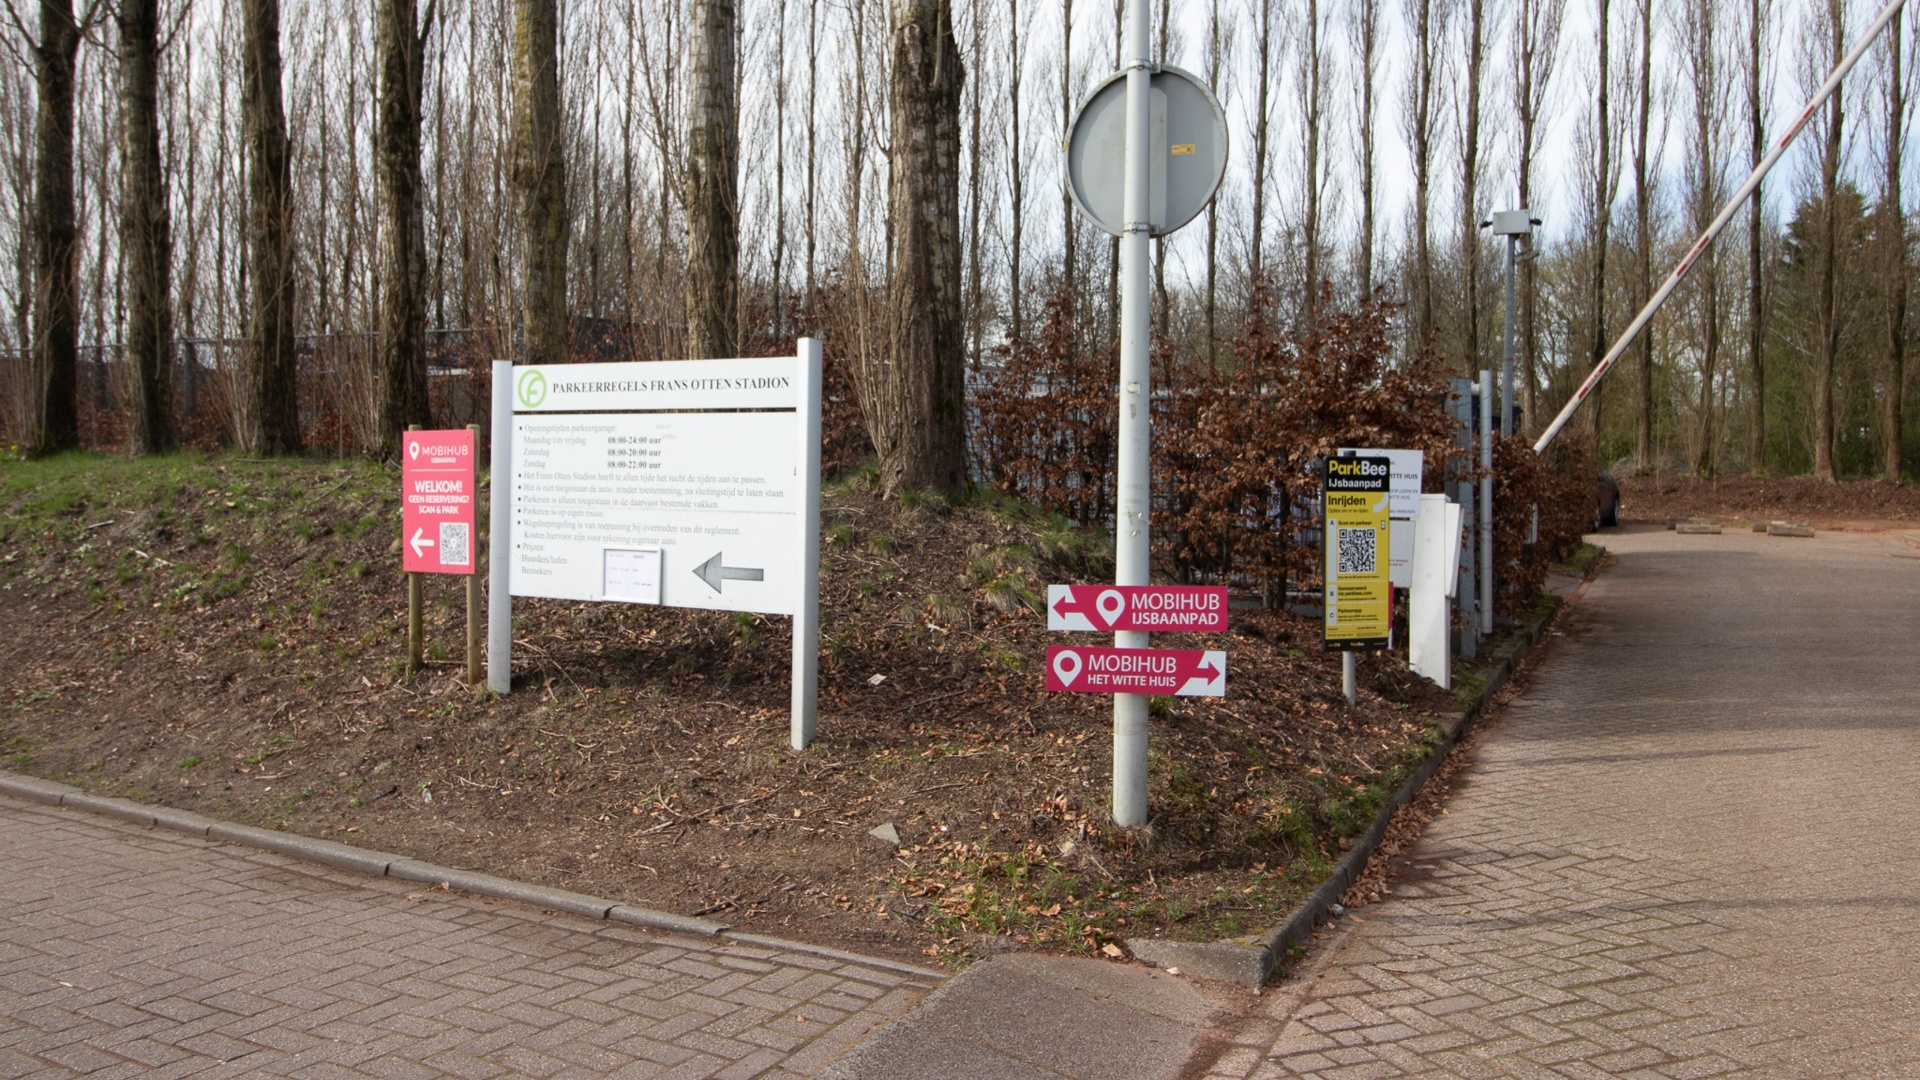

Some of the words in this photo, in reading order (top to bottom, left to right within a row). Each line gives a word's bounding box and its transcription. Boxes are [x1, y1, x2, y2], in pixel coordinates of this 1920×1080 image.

[553, 380, 648, 393] PARKEERREGELS
[650, 380, 688, 391] FRANS
[690, 378, 732, 390] OTTEN
[735, 377, 790, 389] STADION
[524, 424, 570, 434] Openingstijden
[571, 425, 616, 434] parkeergarage:
[523, 436, 551, 446] Maandag
[564, 437, 586, 446] vrijdag
[607, 436, 648, 444] 08:00-24:00
[422, 445, 468, 456] MOBIHUB
[523, 448, 550, 457] Zaterdag
[523, 460, 546, 469] Zondag
[607, 460, 648, 468] 08:00-22:00
[1329, 460, 1387, 476] ParkBee
[523, 472, 535, 480] Het
[536, 472, 553, 480] Frans
[554, 472, 571, 480] Otten
[573, 472, 596, 480] Stadion
[598, 472, 614, 481] heeft
[623, 473, 639, 481] allen
[640, 474, 655, 484] tijde
[657, 474, 667, 482] het
[668, 474, 685, 482] recht
[687, 474, 695, 482] de
[697, 474, 716, 484] tijden
[740, 477, 766, 485] passen.
[1329, 478, 1382, 489] IJsbaanpad
[414, 481, 463, 493] WELKOM!
[555, 485, 588, 494] toegestaan
[598, 486, 614, 494] auto,
[616, 486, 637, 494] zonder
[639, 487, 683, 497] toestemming,
[695, 488, 736, 498] sluitingstijd
[746, 488, 763, 497] laten
[408, 495, 425, 503] GEEN
[425, 495, 469, 503] RESERVERING?
[523, 495, 550, 504] Parkeren
[578, 498, 610, 506] toegestaan
[630, 498, 658, 506] daarvoor
[660, 499, 692, 508] bestemde
[694, 500, 719, 508] vakken.
[1328, 495, 1366, 507] Inrijden
[418, 505, 435, 514] SCAN
[436, 506, 441, 514] &
[442, 506, 459, 514] PARK
[523, 507, 550, 516] Parkeren
[558, 510, 566, 518] op
[567, 510, 584, 519] eigen
[523, 519, 576, 529] Wegsleepregeling
[598, 522, 631, 532] toepassing
[632, 523, 641, 533] bij
[643, 523, 677, 532] overtreden
[693, 525, 702, 533] dit
[524, 531, 545, 540] Kosten
[546, 532, 572, 540] hiervoor
[574, 532, 585, 543] zijn
[603, 534, 630, 544] rekening
[632, 535, 659, 545] eigenaar
[521, 566, 552, 575] Bezoekers
[1131, 593, 1220, 610] MOBIHUB
[1132, 613, 1219, 625] IJSBAANPAD
[1088, 654, 1177, 674] MOBIHUB
[1088, 674, 1110, 685] HET
[1112, 675, 1146, 686] WITTE
[1149, 676, 1176, 687] HUIS
